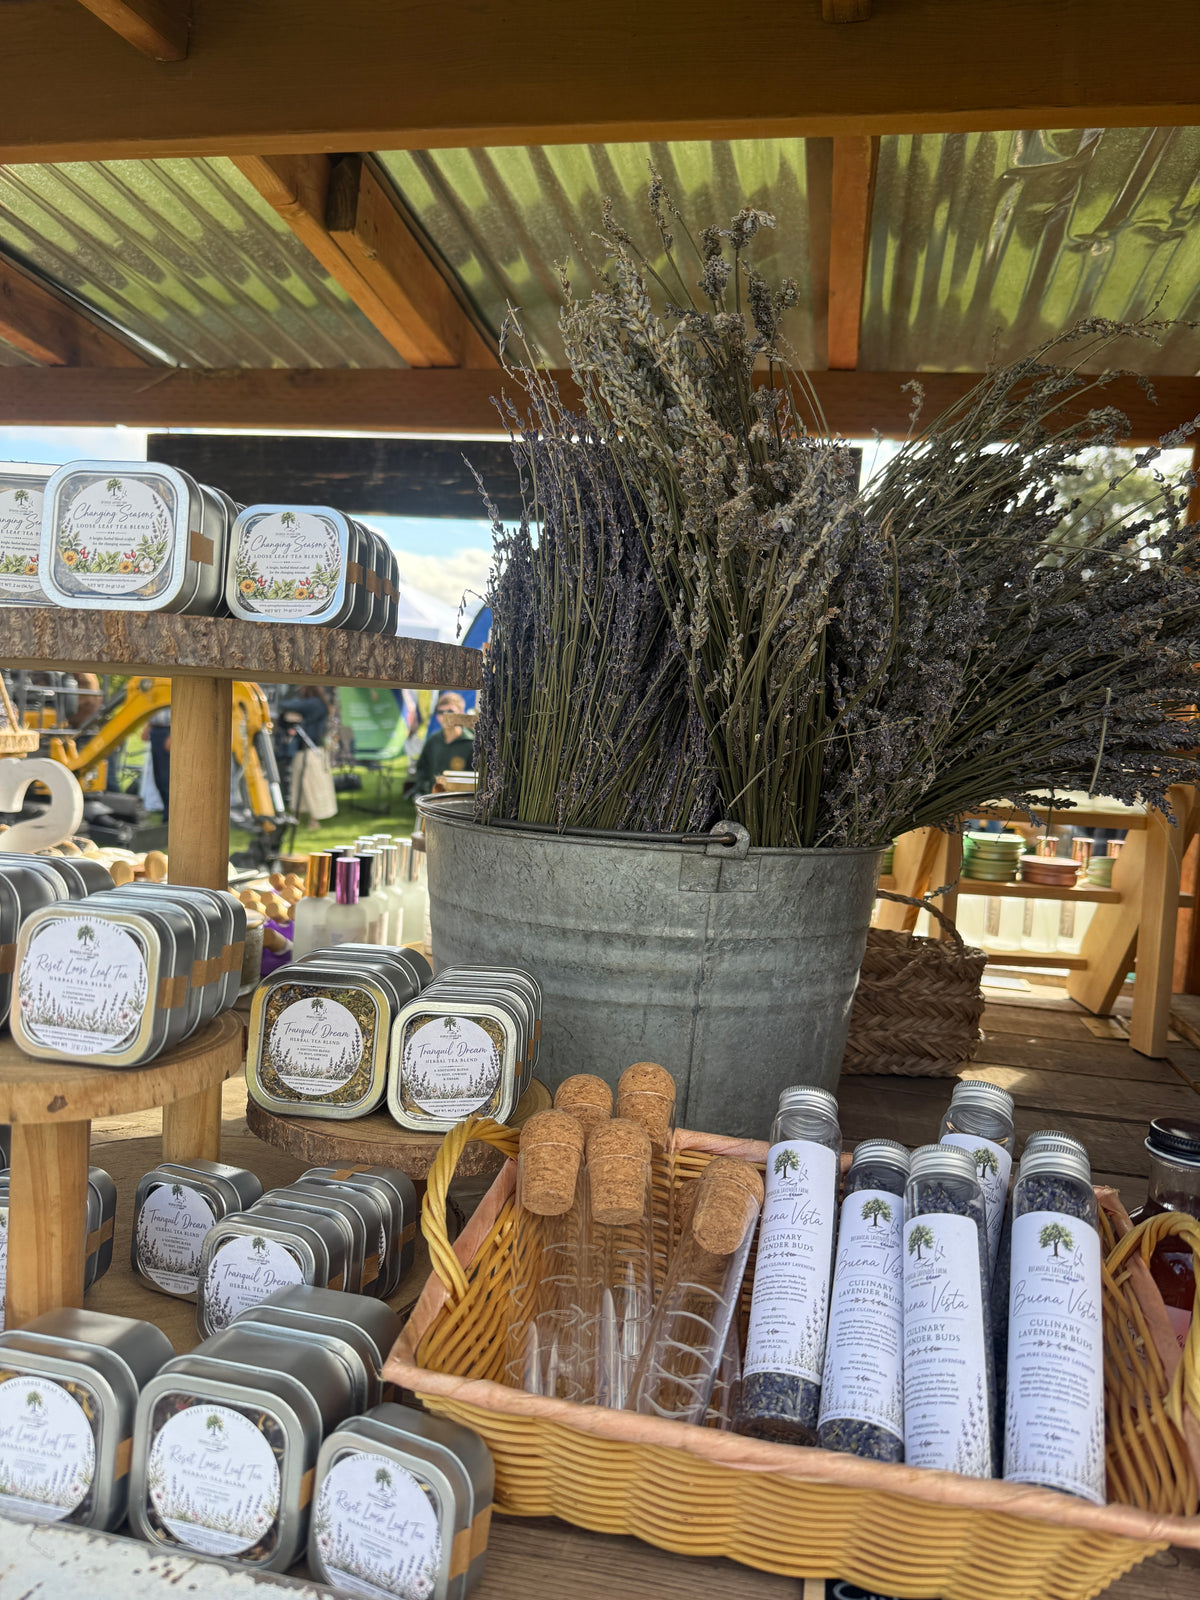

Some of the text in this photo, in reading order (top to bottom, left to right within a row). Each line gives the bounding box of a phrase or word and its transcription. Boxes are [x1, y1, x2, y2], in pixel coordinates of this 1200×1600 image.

[73, 502, 155, 524] Changing Seasons
[251, 535, 327, 554] Changing Seasons
[36, 953, 63, 972] Reset
[65, 958, 87, 976] Loose
[90, 961, 112, 981] Leaf
[113, 964, 129, 980] Tea
[49, 975, 113, 989] HERBAL TEA BLEND
[283, 1021, 350, 1039] Tranquil Dream
[418, 1041, 487, 1058] Tranquil Dream
[149, 1209, 207, 1230] Tranquil Dream
[791, 1200, 823, 1226] Vista
[763, 1233, 802, 1244] CULINARY
[791, 1240, 814, 1252] BUDS
[222, 1263, 261, 1285] Tranquil
[836, 1248, 880, 1281] Buena
[229, 1282, 251, 1291] HERBAL
[838, 1287, 880, 1298] LAVENDER
[848, 1280, 894, 1293] CULINARY
[932, 1280, 969, 1313] Vista
[1013, 1280, 1099, 1322] Buena Vista
[906, 1323, 945, 1338] CULINARY
[1029, 1319, 1082, 1334] CULINARY
[935, 1333, 961, 1342] BUDS
[1018, 1328, 1093, 1351] LAVENDER BUDS
[169, 1444, 263, 1481] Reset Loose Leaf Tea
[387, 1512, 409, 1538] Leaf
